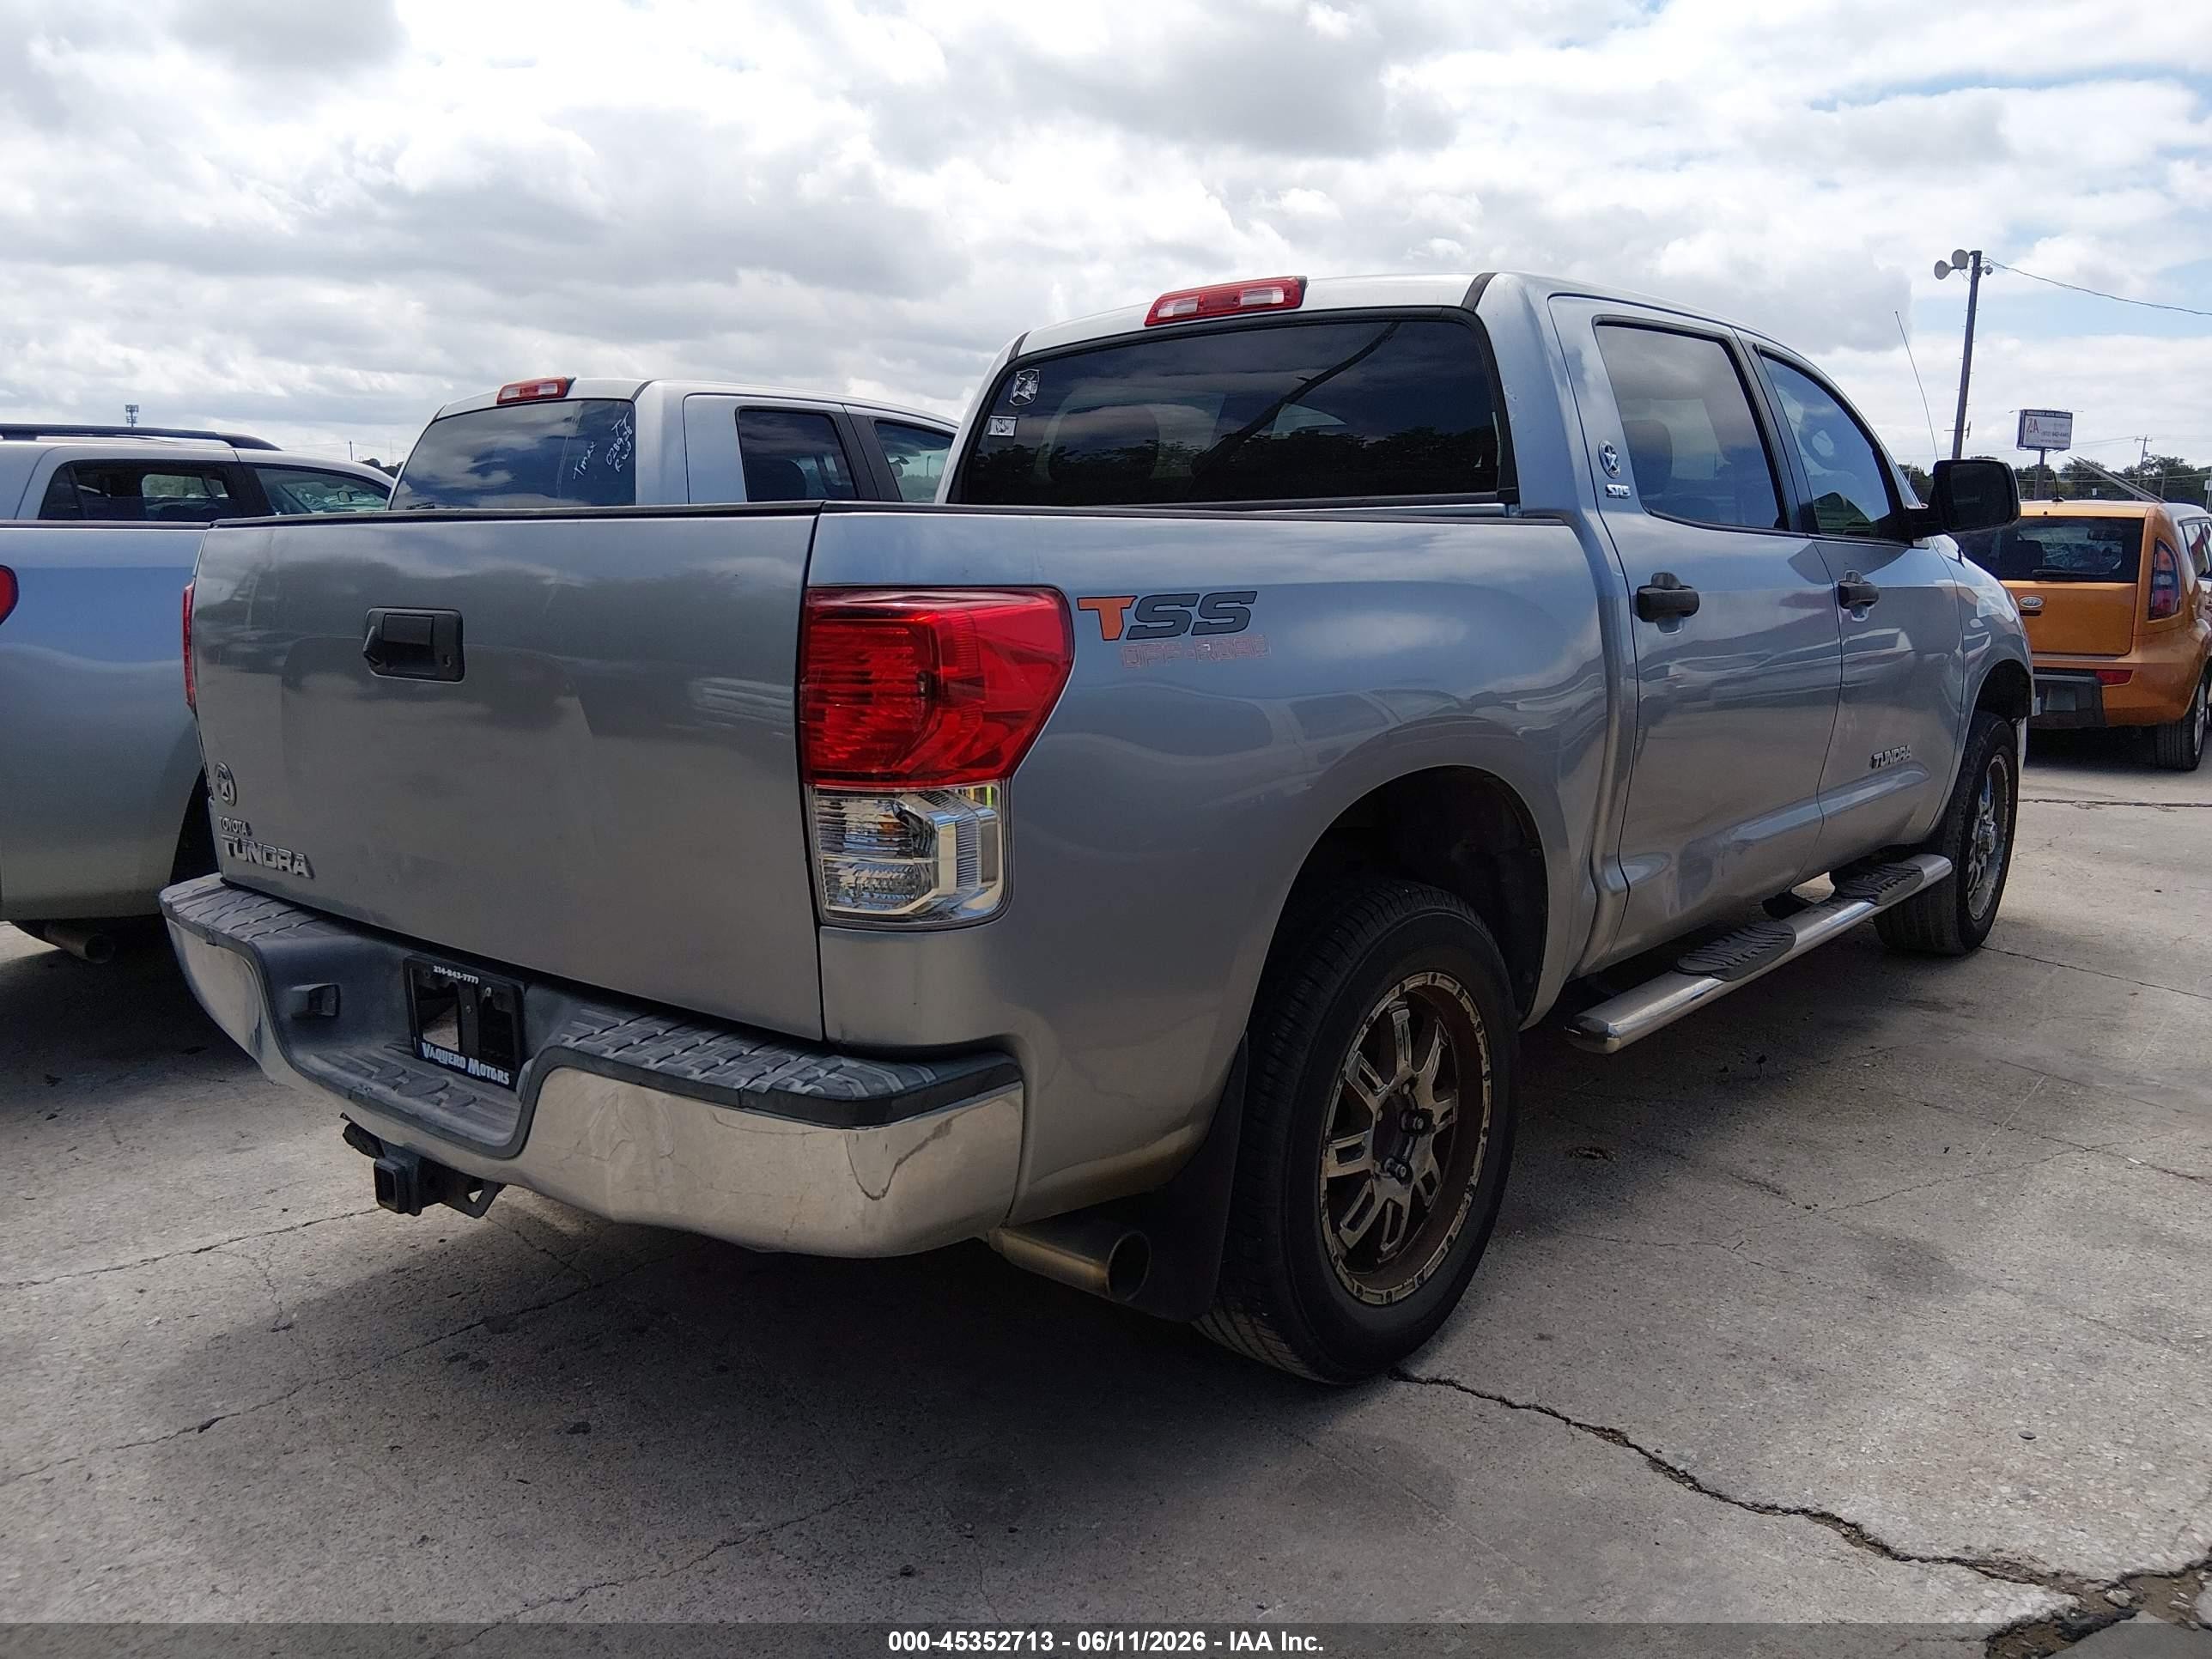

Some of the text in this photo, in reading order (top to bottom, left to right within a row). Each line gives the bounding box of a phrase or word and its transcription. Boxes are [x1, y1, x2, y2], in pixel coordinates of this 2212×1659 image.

[1077, 590, 1258, 641] TSS
[1871, 744, 1911, 769] TUNDRA
[218, 816, 250, 836] TOYOTA
[221, 834, 313, 879] TUNDRA
